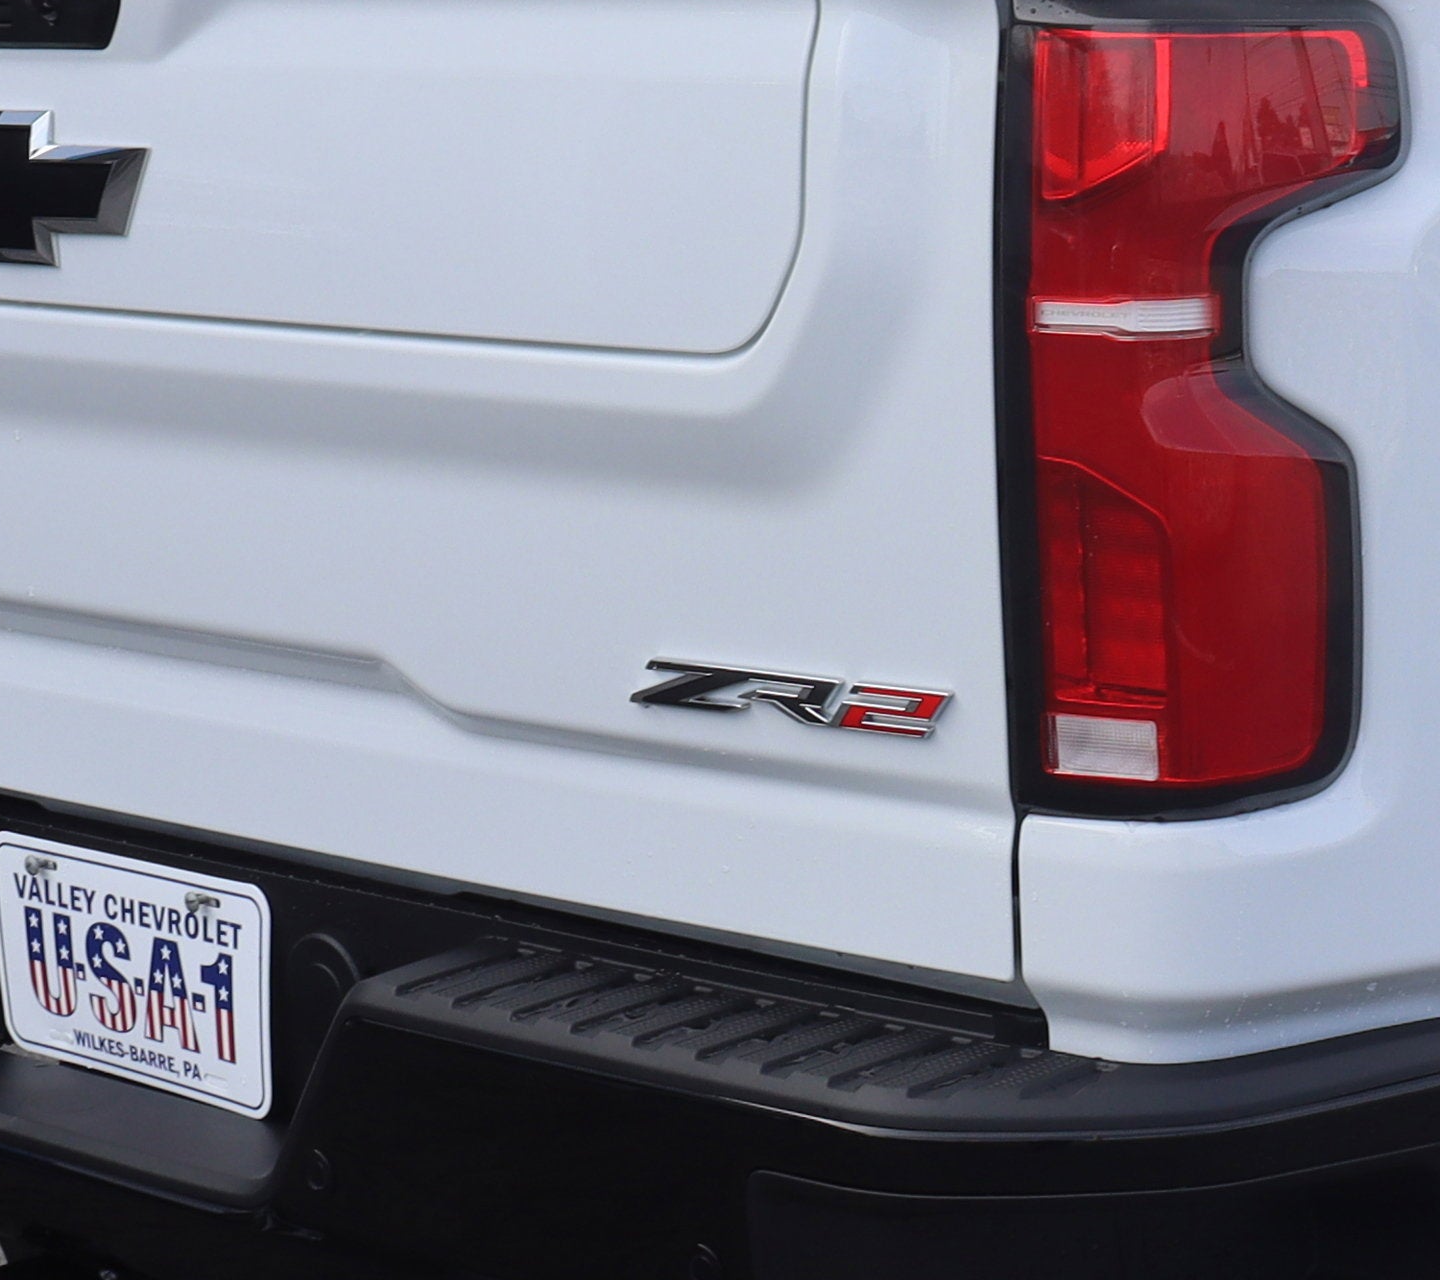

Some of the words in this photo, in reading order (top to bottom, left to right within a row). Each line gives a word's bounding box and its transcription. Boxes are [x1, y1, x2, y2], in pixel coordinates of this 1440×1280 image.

[629, 657, 955, 739] ZR2
[13, 872, 97, 915] VALLEY
[104, 893, 243, 950] CHEVROLET
[72, 1028, 181, 1077] WILKES-BARRE,
[182, 1059, 203, 1081] PA
